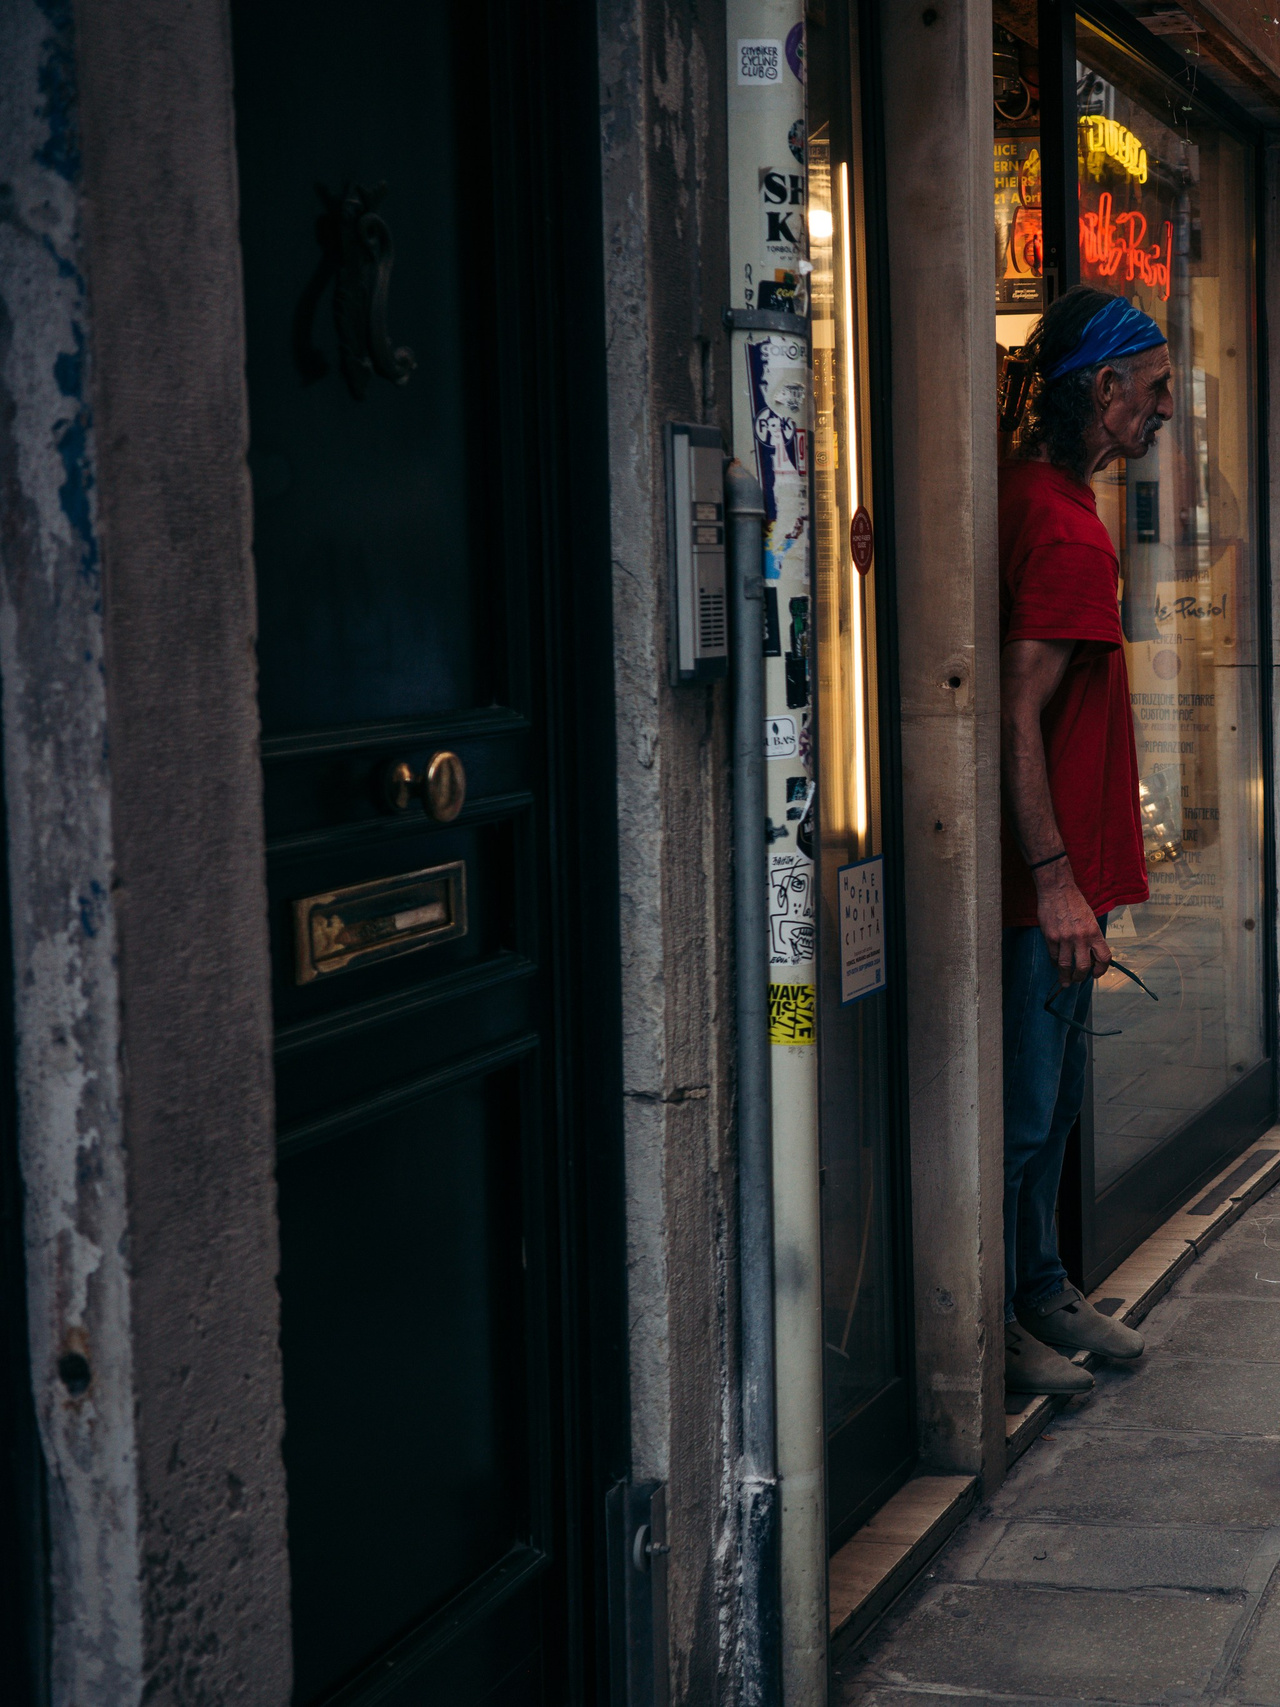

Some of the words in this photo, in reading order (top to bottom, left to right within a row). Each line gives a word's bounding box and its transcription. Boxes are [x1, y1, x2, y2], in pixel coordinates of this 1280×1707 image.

[741, 55, 778, 67] CYCLING
[741, 65, 765, 78] CLUB
[994, 144, 1017, 156] ICE
[994, 176, 1035, 188] HIERS
[1010, 192, 1041, 205] Apri
[1129, 693, 1175, 706] OSTRUZIONE
